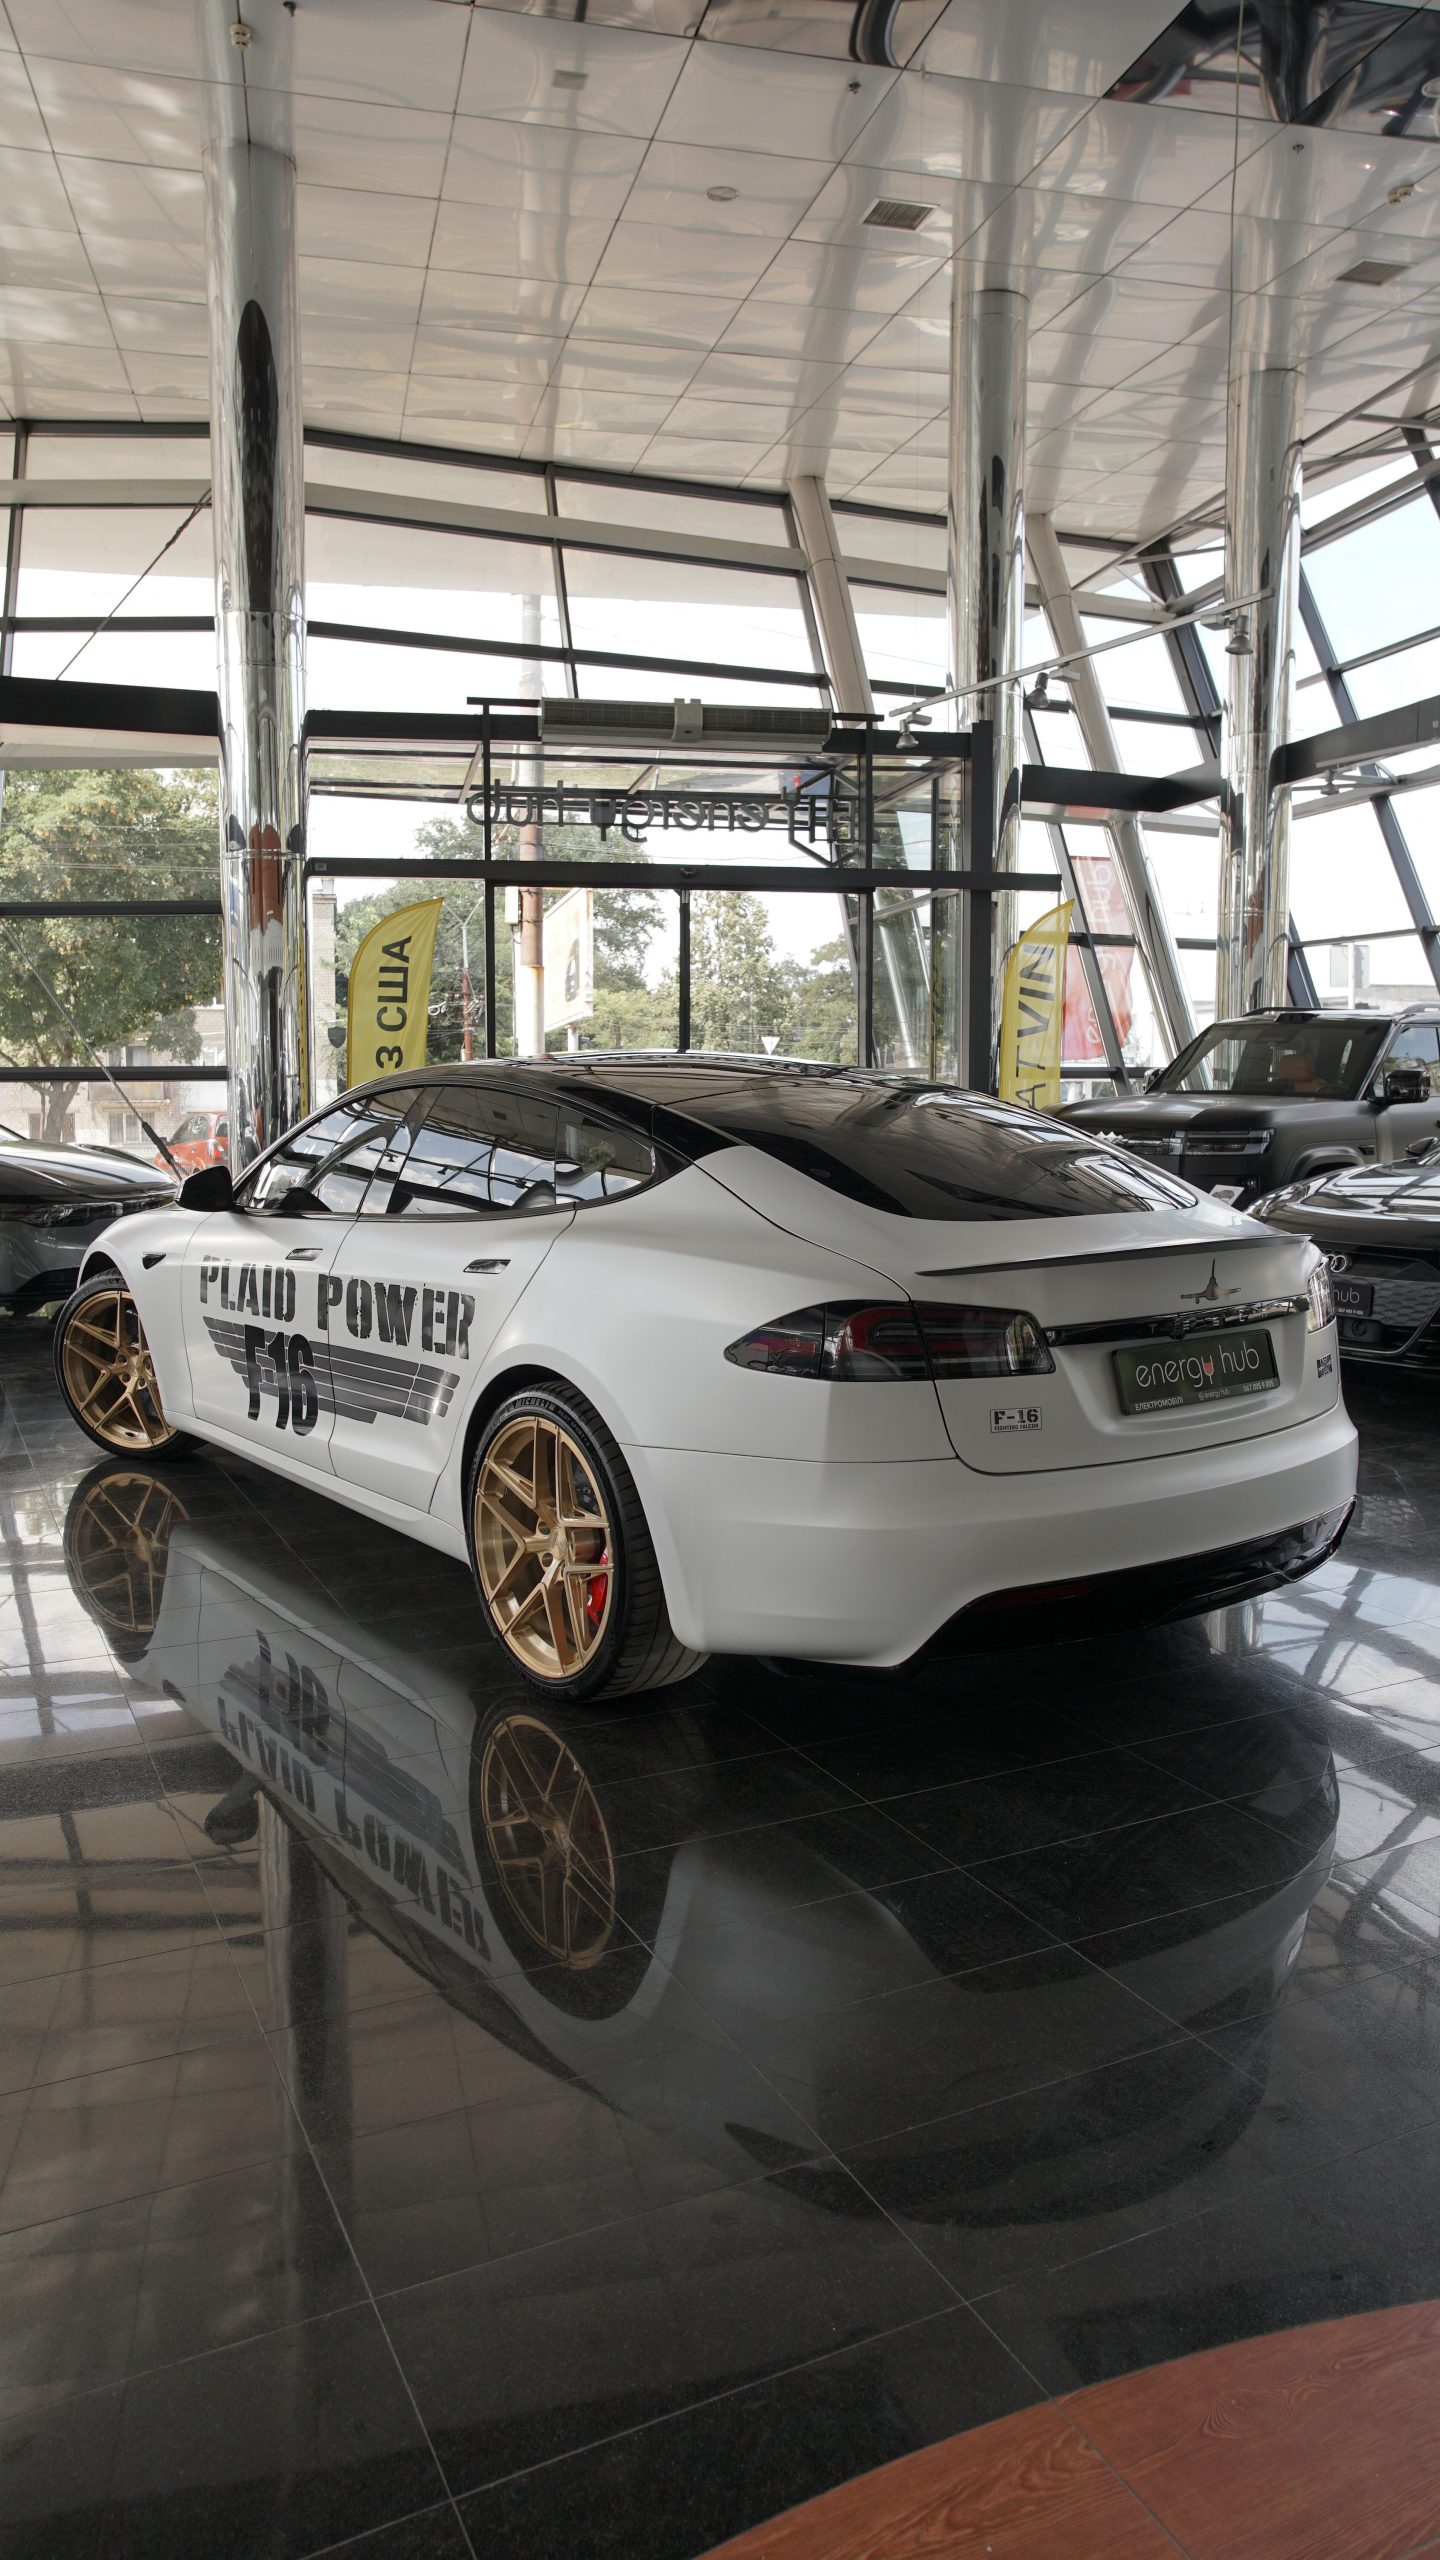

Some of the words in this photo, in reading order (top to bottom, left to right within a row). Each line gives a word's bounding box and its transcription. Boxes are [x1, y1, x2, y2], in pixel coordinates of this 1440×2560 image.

[376, 936, 412, 1032] США
[200, 1254, 296, 1322] PLAID
[318, 1273, 475, 1359] POWER
[1135, 1352, 1213, 1388] energy
[1219, 1340, 1260, 1374] hub
[515, 1397, 556, 1411] MICHELIN
[994, 1408, 1039, 1425] F-16
